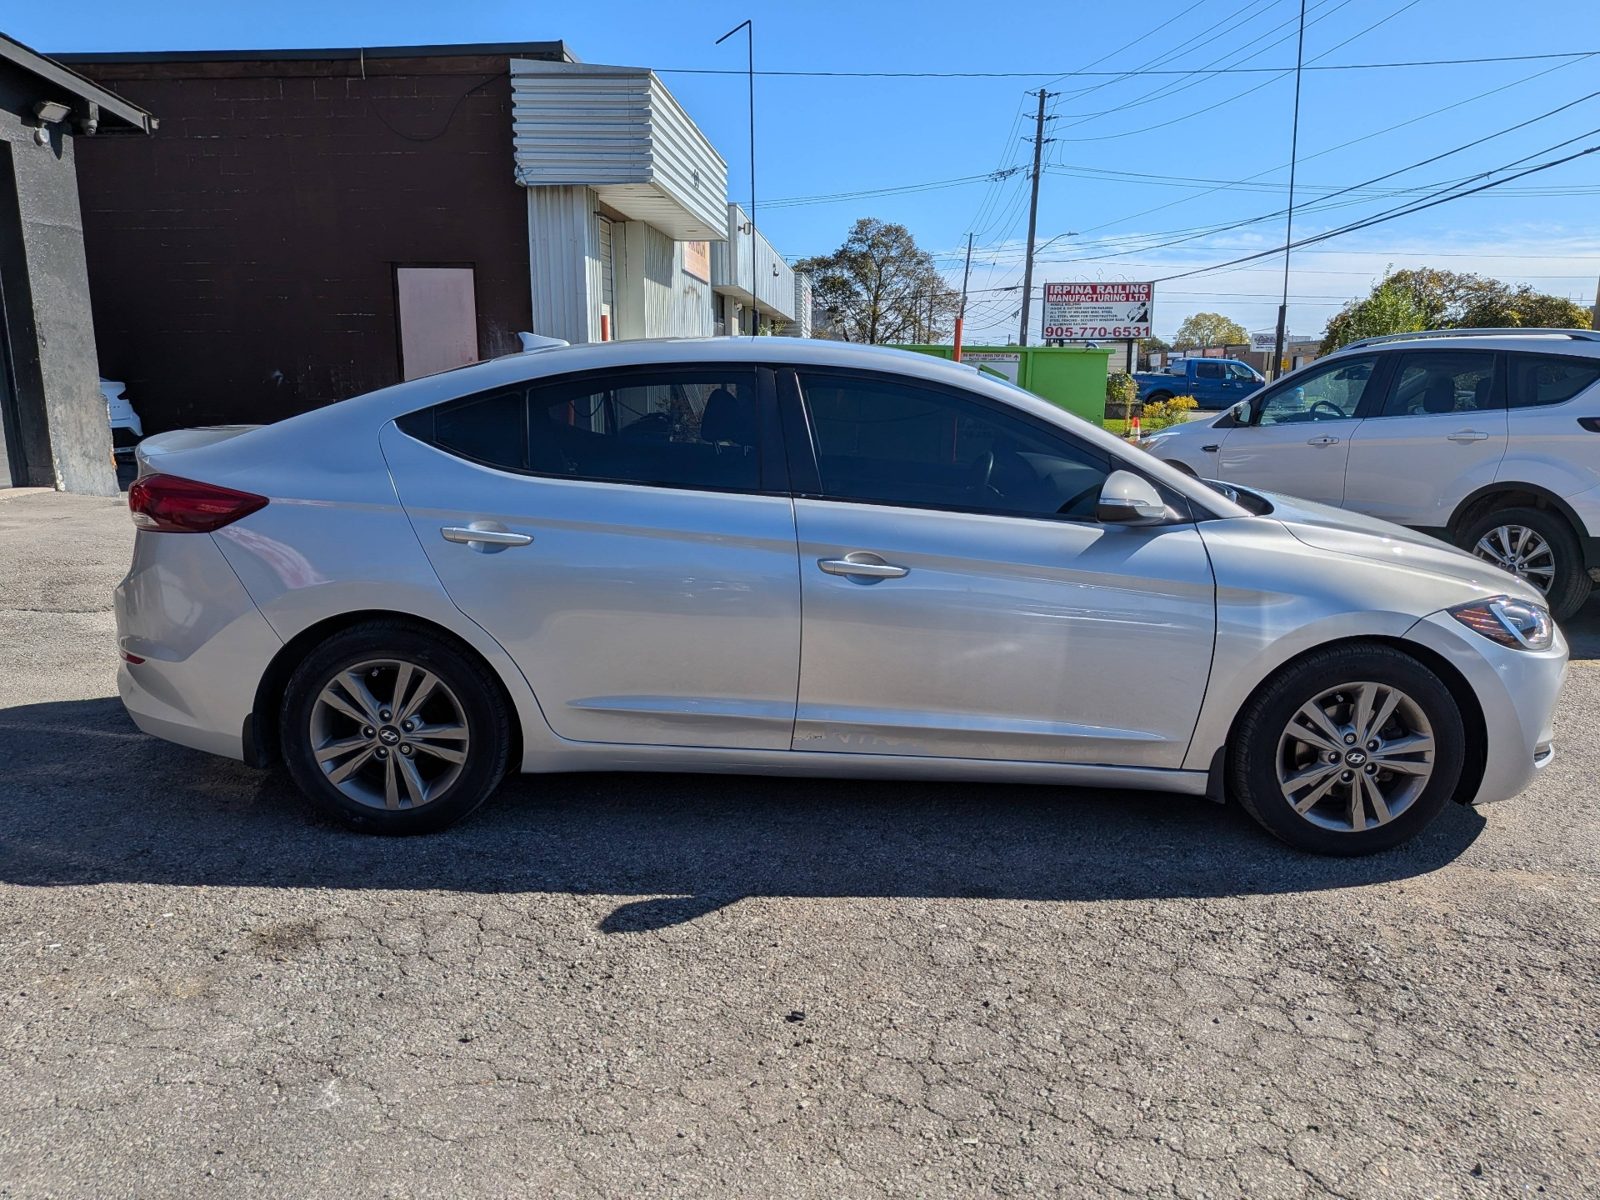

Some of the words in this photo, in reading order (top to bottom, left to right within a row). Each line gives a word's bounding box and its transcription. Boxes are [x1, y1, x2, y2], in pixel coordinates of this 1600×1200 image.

[1049, 285, 1093, 294] IRPINA
[1096, 284, 1149, 293] RAILING
[1048, 293, 1127, 302] MANUFACTURING
[1128, 293, 1149, 302] LTD.
[1045, 326, 1150, 337] 905-770-6531
